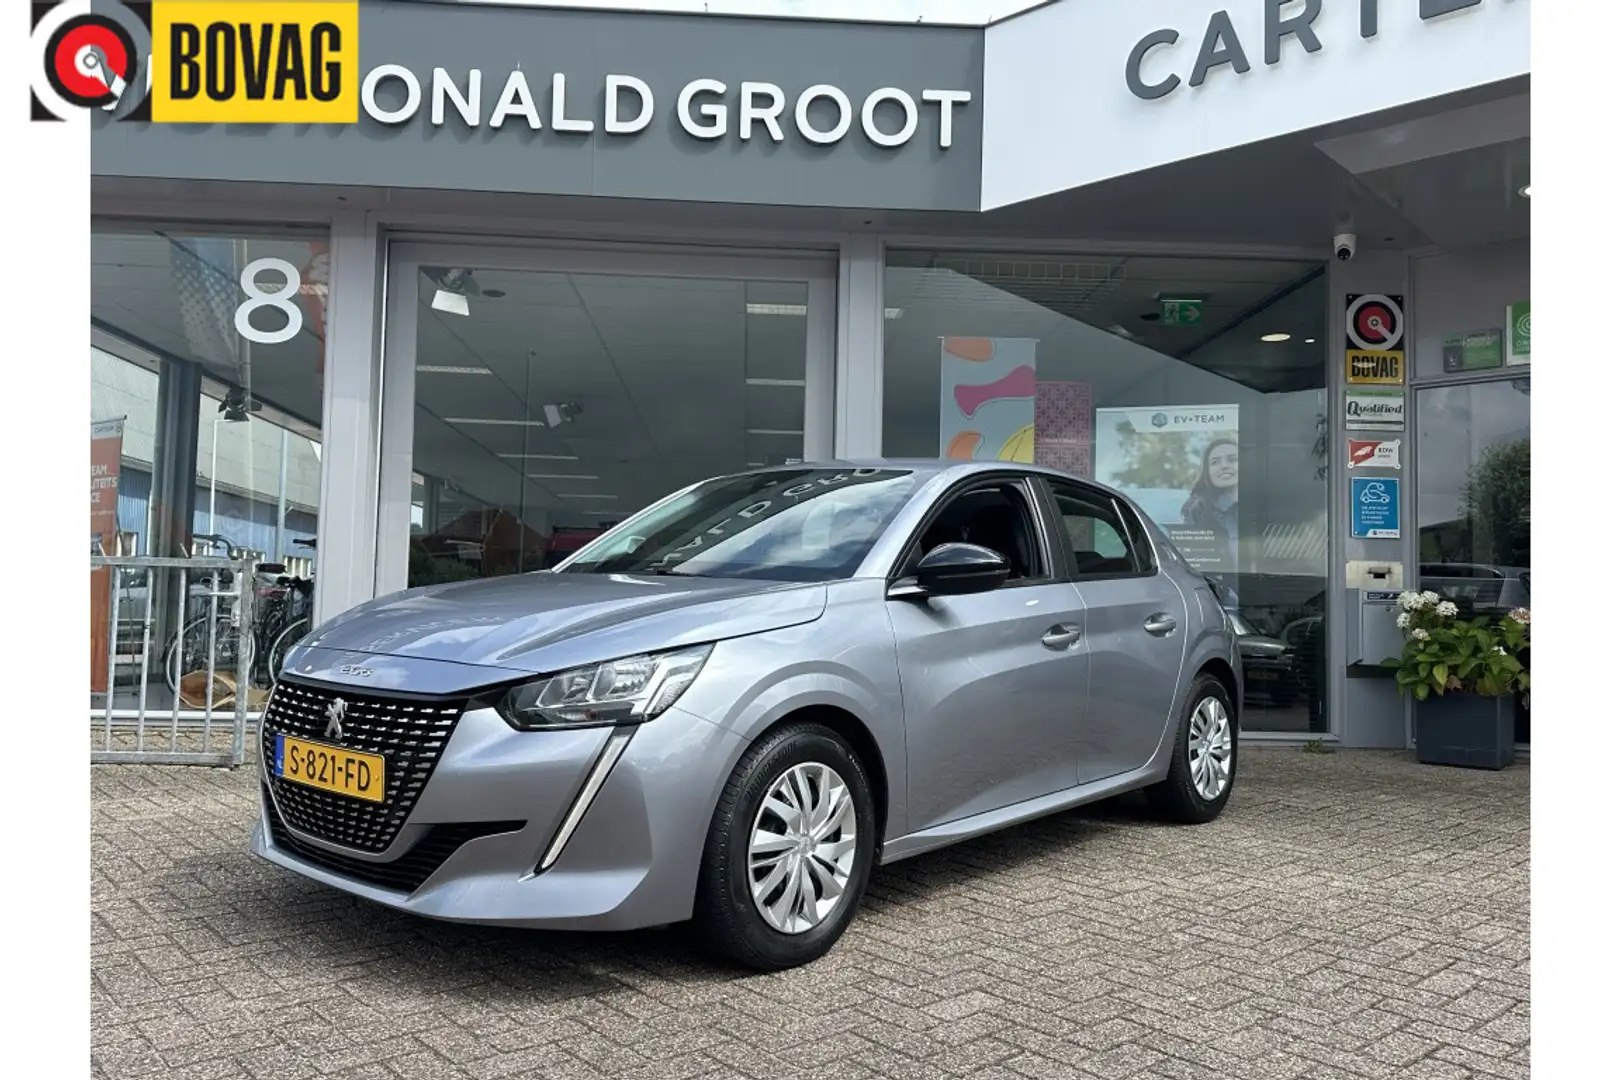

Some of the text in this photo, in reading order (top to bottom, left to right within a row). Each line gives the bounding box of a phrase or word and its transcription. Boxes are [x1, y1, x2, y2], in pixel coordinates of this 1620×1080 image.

[1125, 0, 1481, 100] CAR
[361, 63, 972, 148] ONALD GROOT
[234, 257, 303, 343] 8
[1351, 354, 1399, 379] BOVAG
[1347, 400, 1403, 417] Qualified
[91, 464, 107, 476] EAM
[289, 745, 371, 792] S-821-FD
